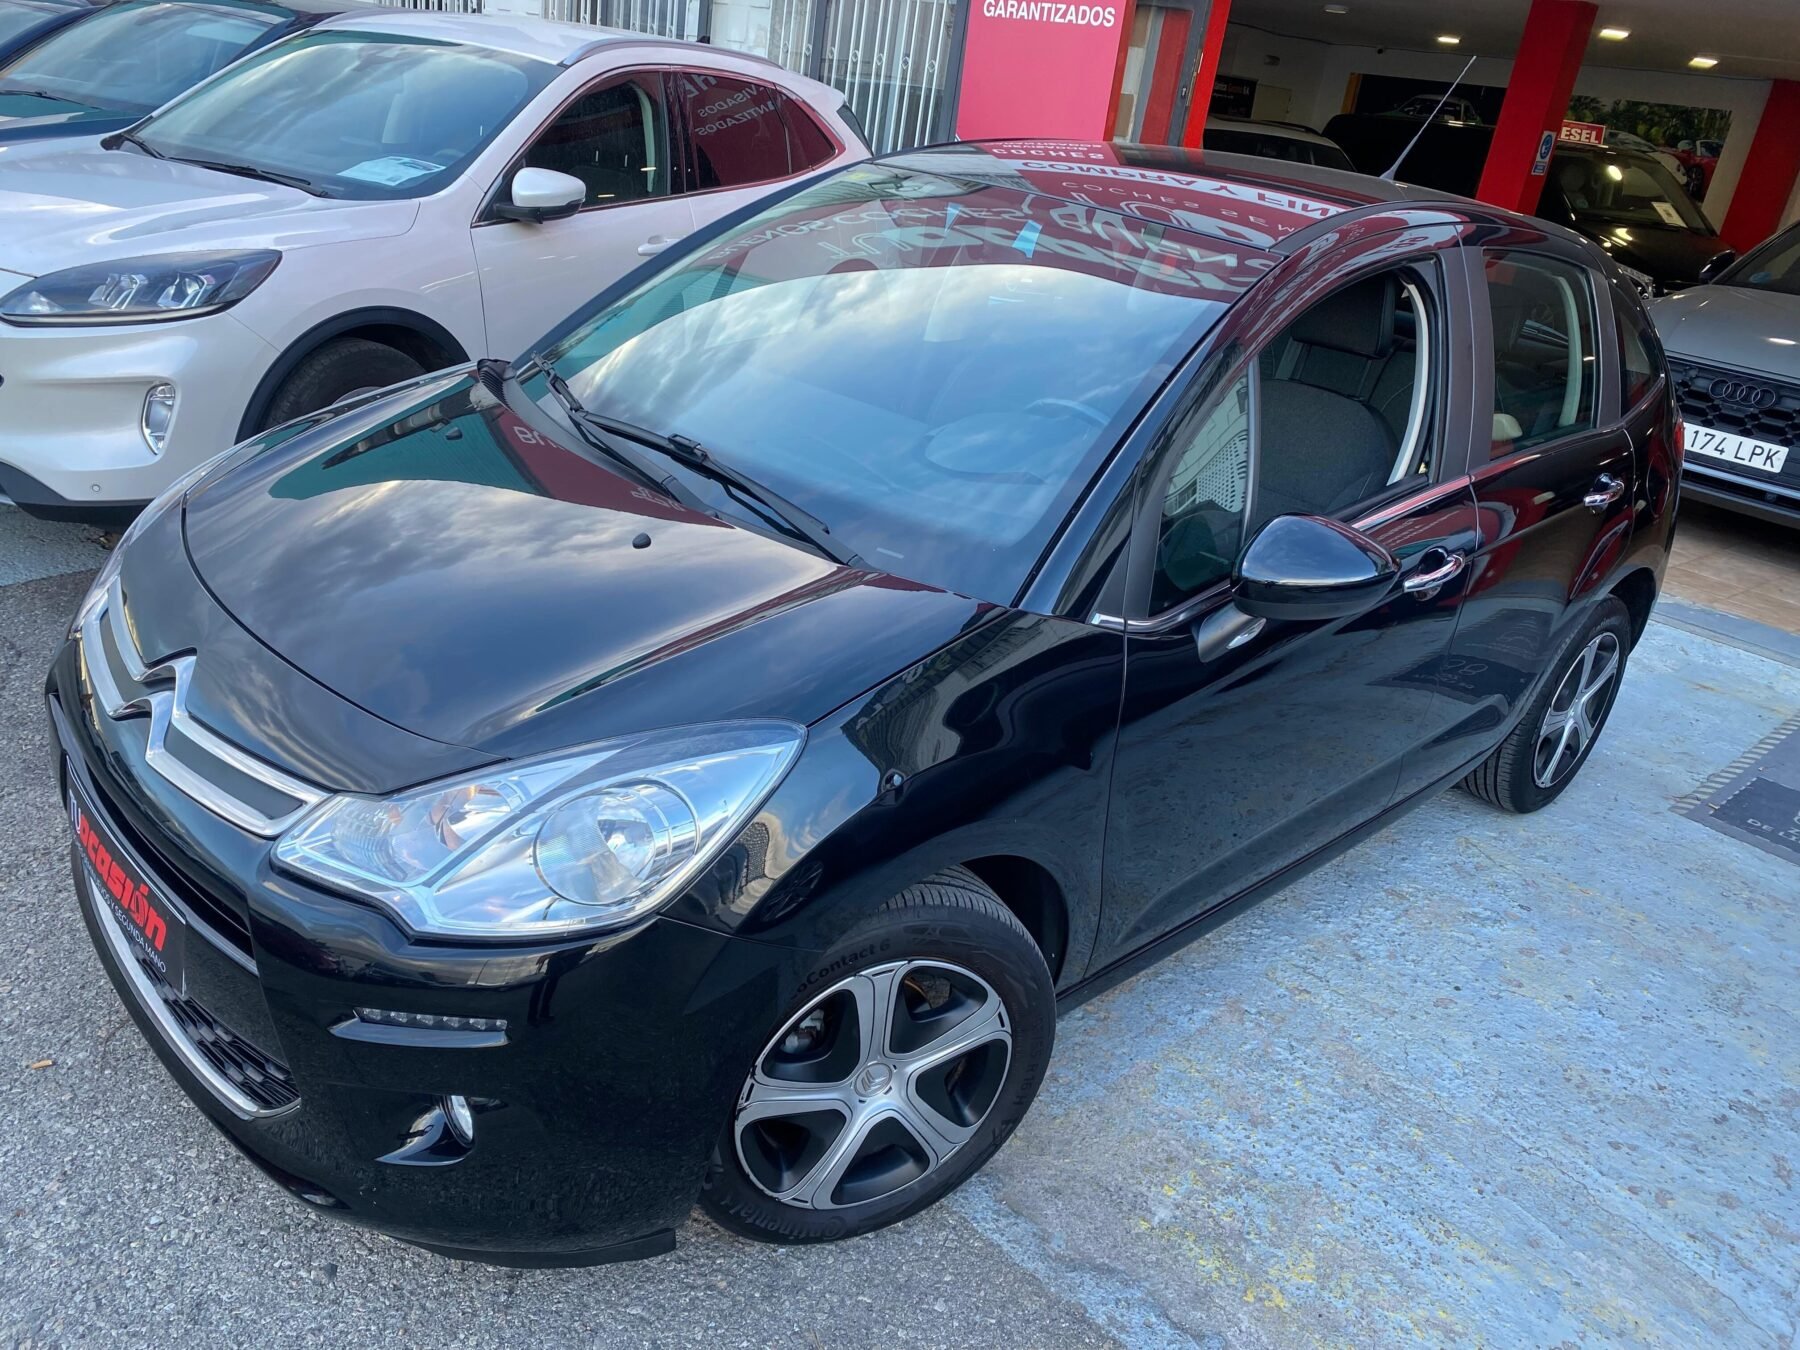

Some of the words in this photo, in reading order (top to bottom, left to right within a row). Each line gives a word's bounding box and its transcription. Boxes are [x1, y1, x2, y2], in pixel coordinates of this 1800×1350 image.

[983, 0, 1116, 27] GARANTIZADOS
[1560, 126, 1599, 144] ESEL
[1690, 429, 1727, 456] 174
[1733, 440, 1781, 469] LPK
[791, 943, 877, 998] oContact
